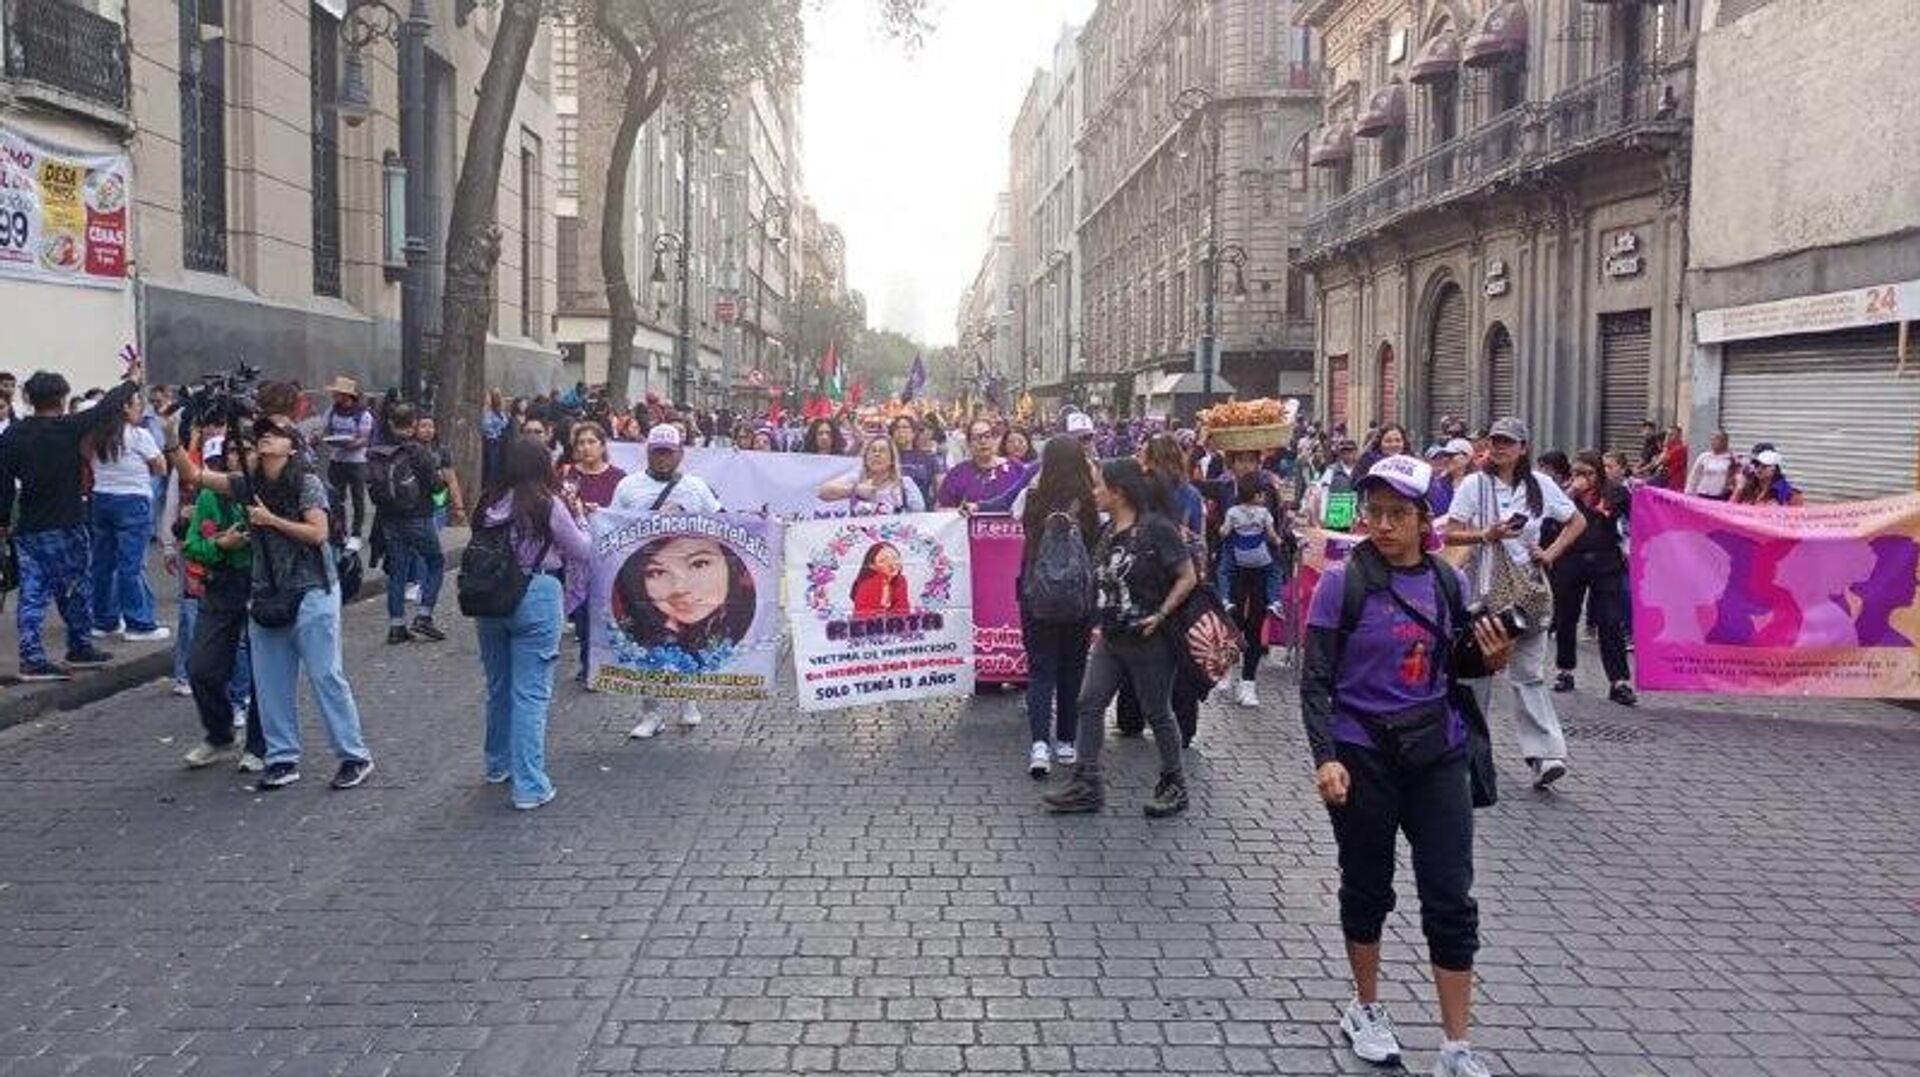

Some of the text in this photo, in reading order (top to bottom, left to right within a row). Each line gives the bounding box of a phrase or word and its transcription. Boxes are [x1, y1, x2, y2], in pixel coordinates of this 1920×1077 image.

[45, 164, 76, 186] DESA
[1866, 286, 1897, 314] 24
[826, 613, 944, 641] RENATA
[863, 649, 879, 661] DE
[815, 671, 957, 701] SOLO TENÍA 13 AÑOS
